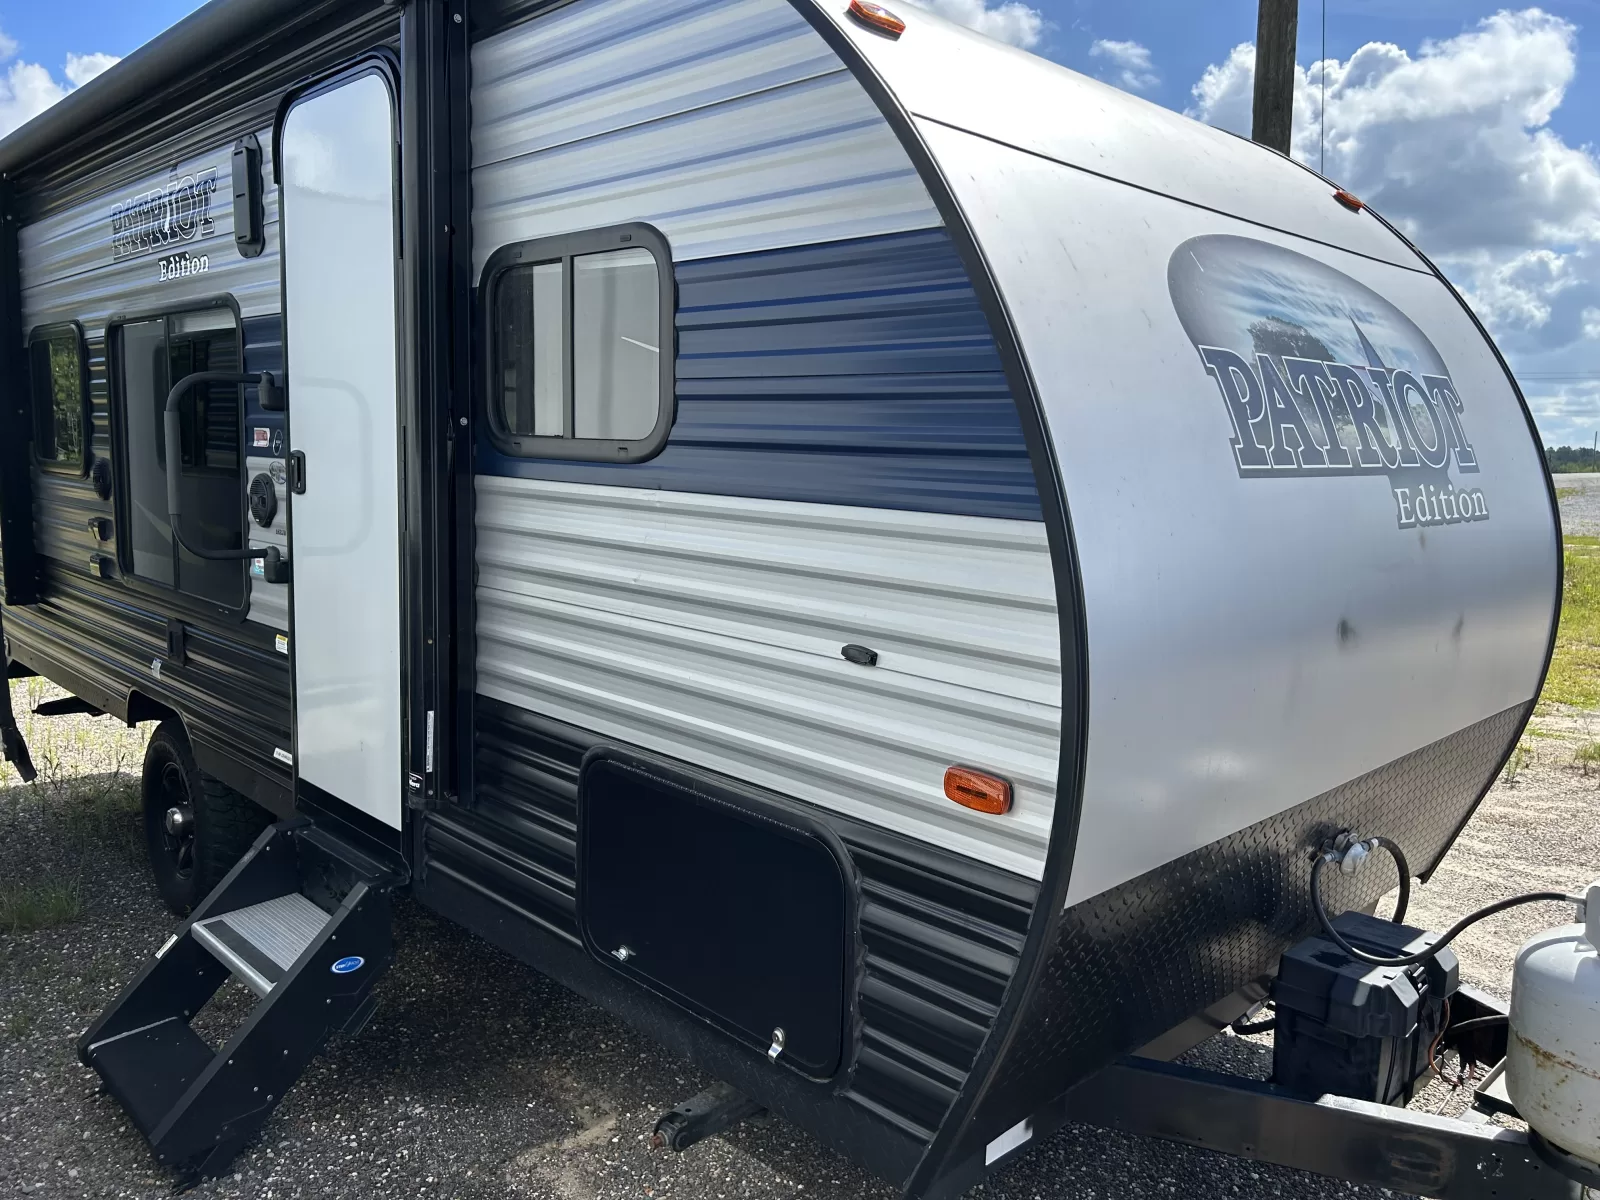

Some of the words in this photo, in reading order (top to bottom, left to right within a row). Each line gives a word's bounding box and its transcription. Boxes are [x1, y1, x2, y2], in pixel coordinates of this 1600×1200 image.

[110, 166, 218, 259] PATRIOT
[158, 253, 210, 282] Edition
[1199, 344, 1478, 471] PATRIOT
[1394, 484, 1488, 524] Edition
